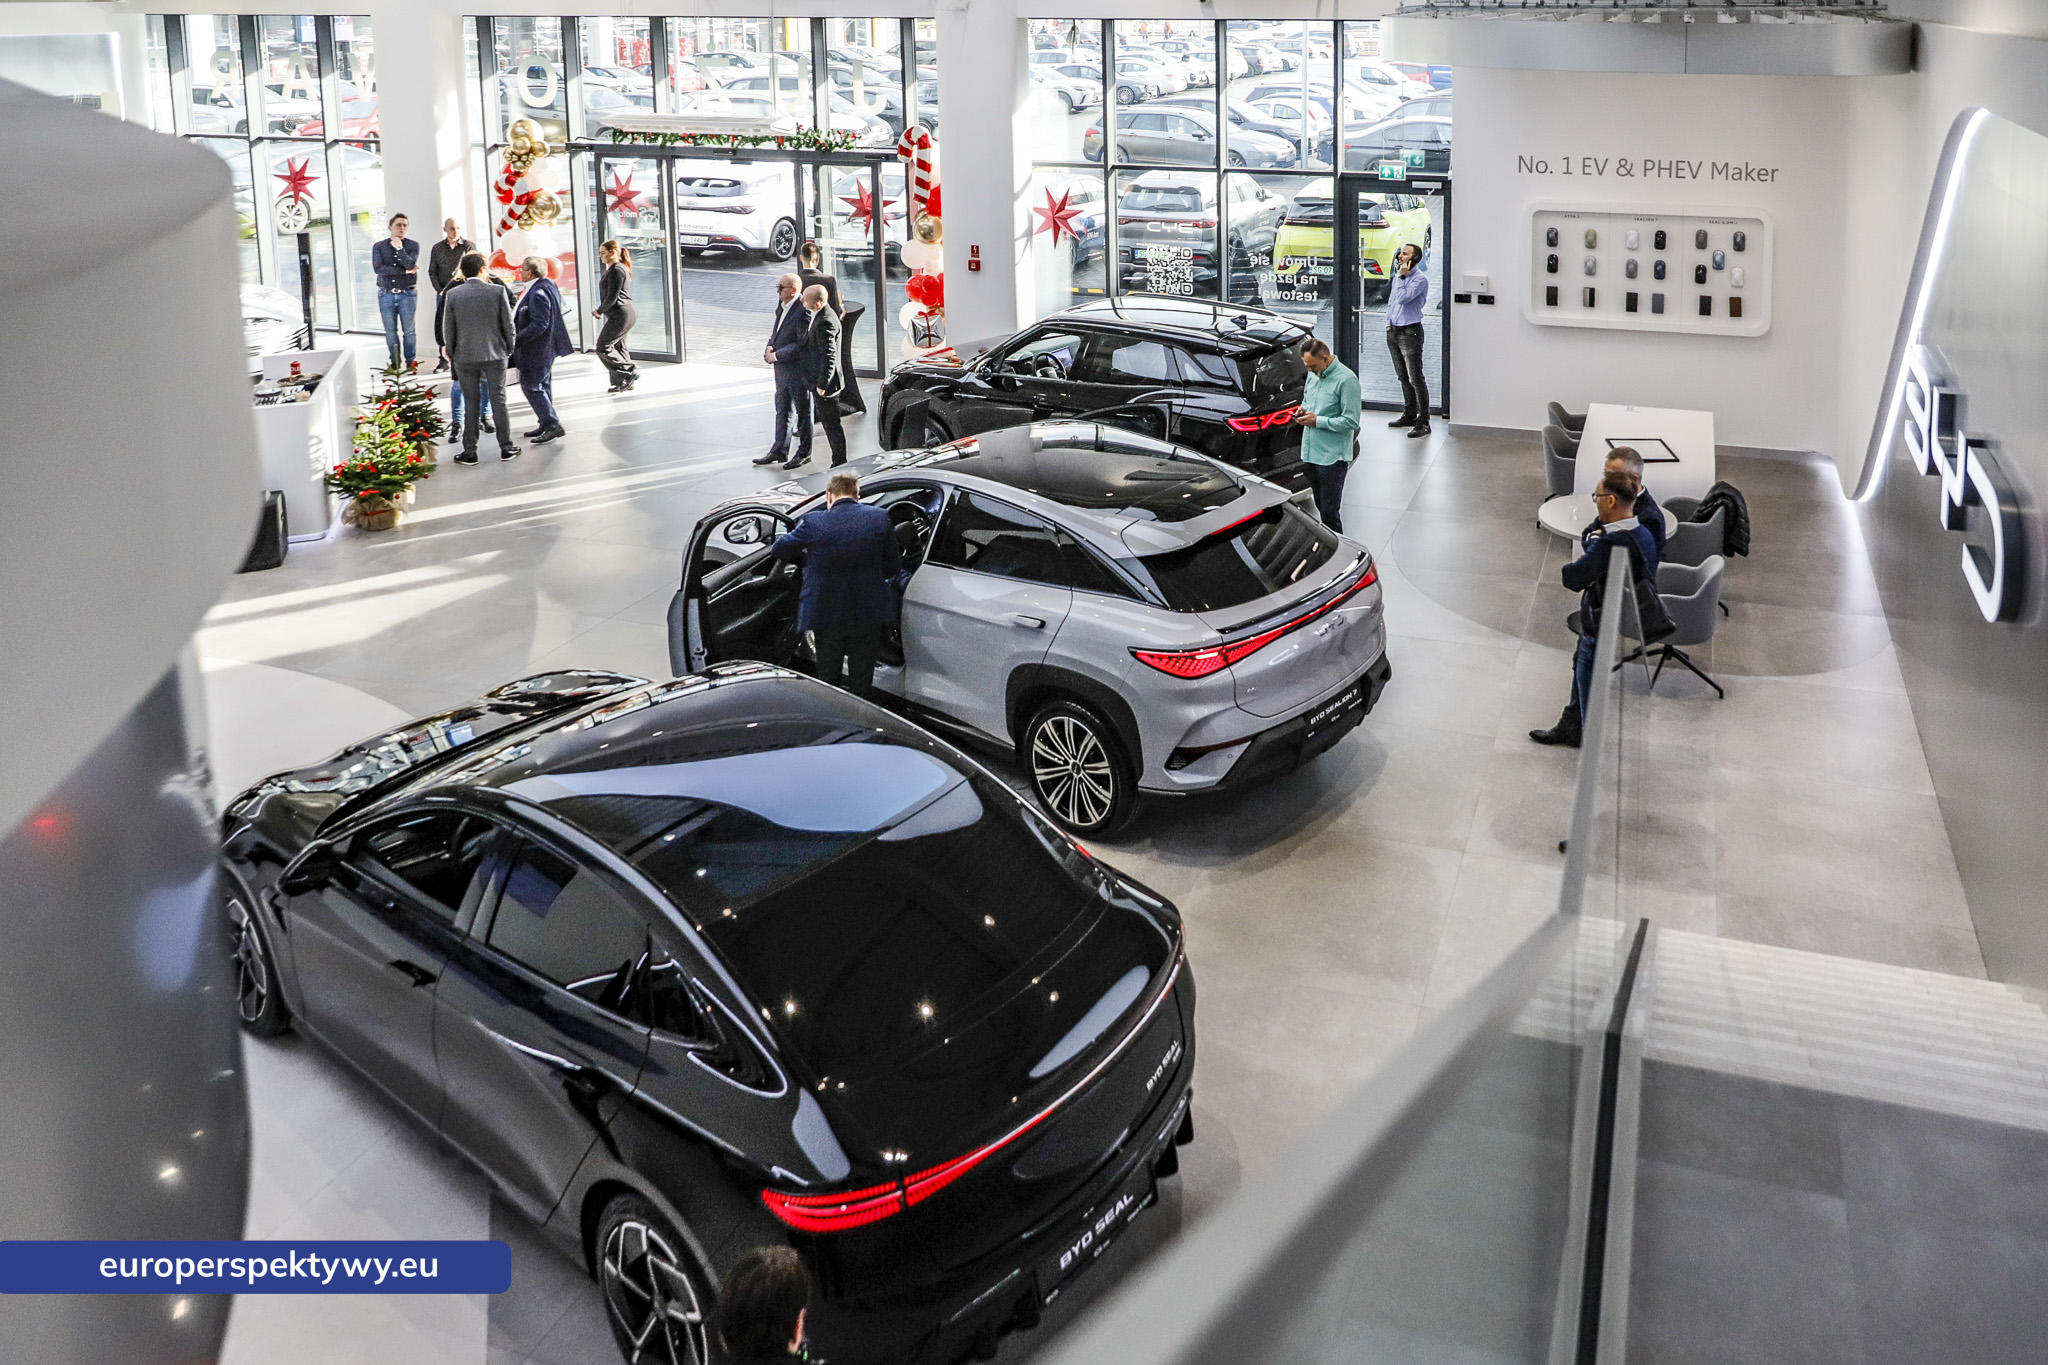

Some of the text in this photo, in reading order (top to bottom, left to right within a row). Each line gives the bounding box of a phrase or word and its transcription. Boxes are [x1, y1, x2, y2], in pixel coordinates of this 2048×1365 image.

[1517, 155, 1780, 183] No. 1 EV & PHEV Maker
[1310, 711, 1326, 726] BYD
[1325, 692, 1352, 715] SEALION
[1146, 1064, 1164, 1092] BYD
[1059, 1230, 1094, 1271] BYD
[1094, 1194, 1134, 1236] SEAL
